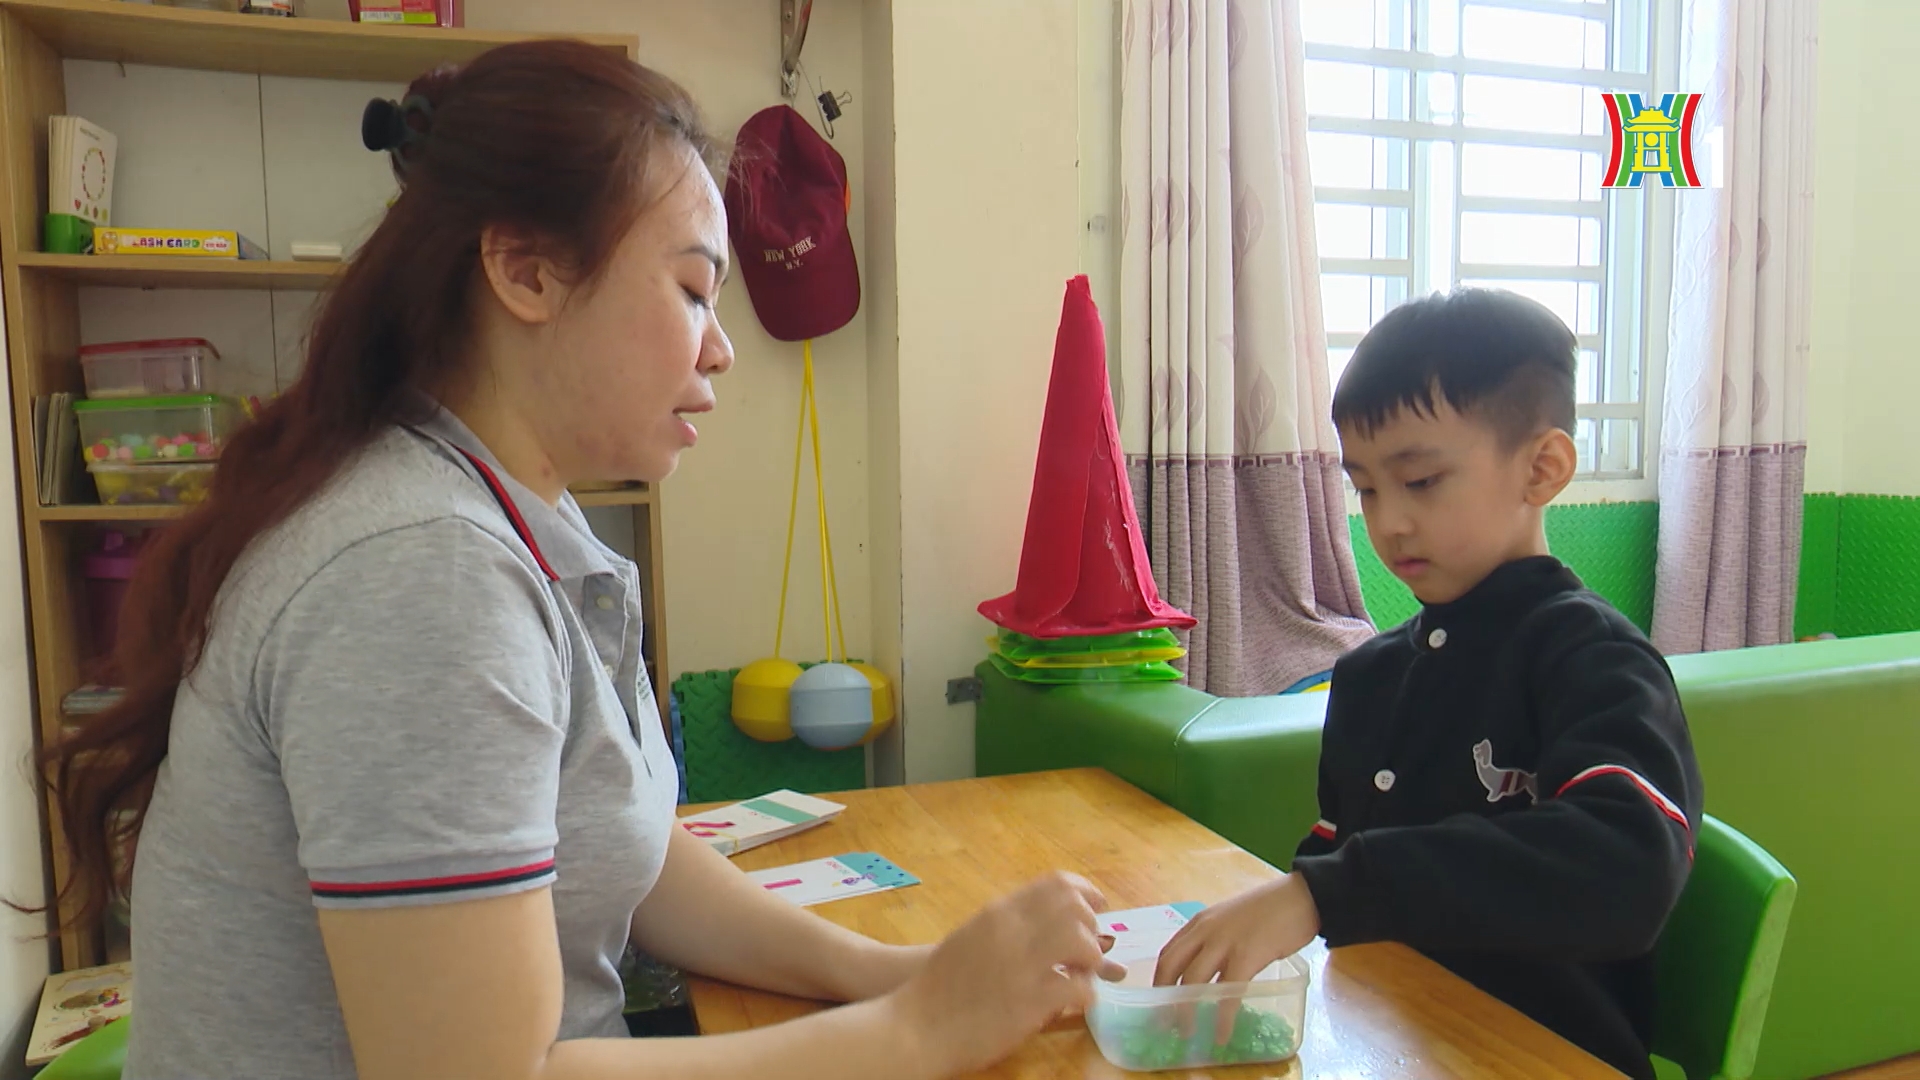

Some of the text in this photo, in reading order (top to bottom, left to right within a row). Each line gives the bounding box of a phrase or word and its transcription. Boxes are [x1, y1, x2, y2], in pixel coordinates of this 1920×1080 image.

[166, 238, 200, 248] CARD
[764, 236, 817, 262] NEW YORK
